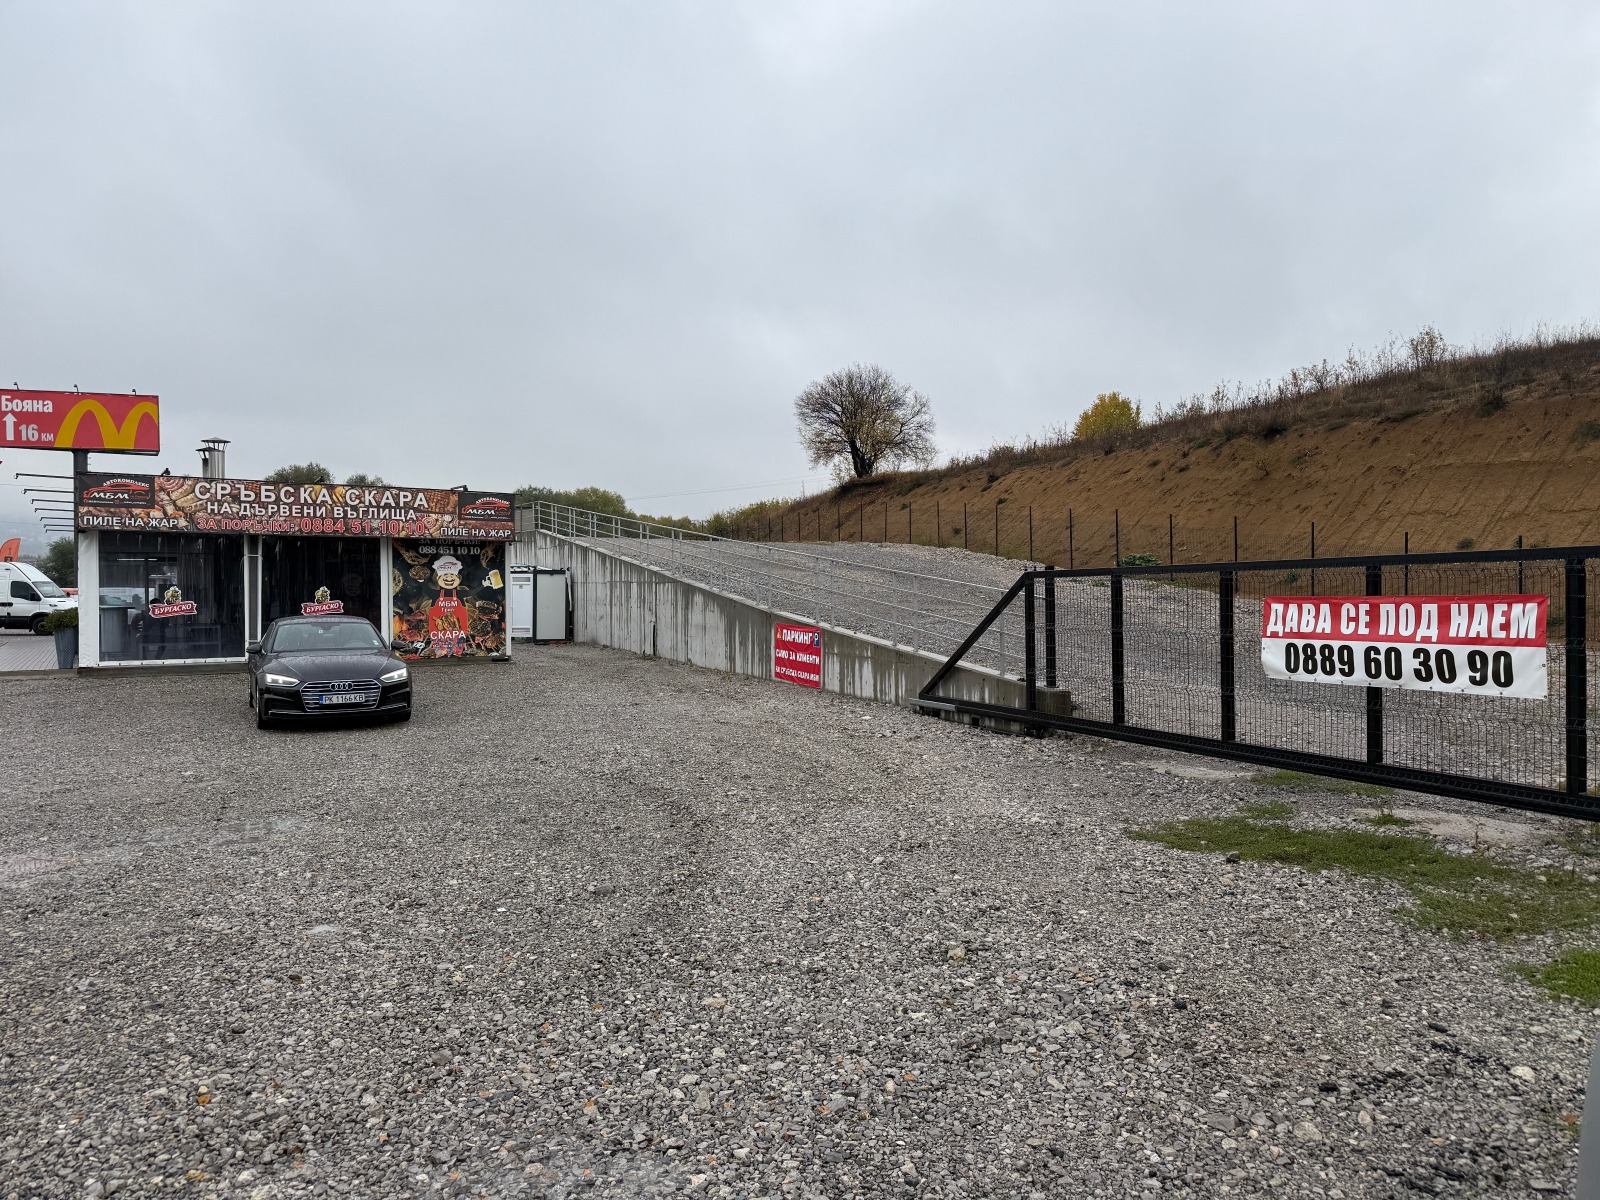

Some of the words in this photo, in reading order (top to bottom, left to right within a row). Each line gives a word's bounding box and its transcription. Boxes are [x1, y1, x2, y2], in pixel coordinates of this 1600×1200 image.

[1, 395, 53, 413] Бояна
[18, 424, 39, 442] 16
[90, 492, 130, 500] МБМ
[194, 482, 332, 504] СРЪБСКА
[345, 489, 429, 508] СКАРА
[207, 501, 232, 514] НА
[239, 504, 326, 518] ДЪРВЕНИ
[333, 506, 417, 522] ВЪГЛИЩА
[83, 516, 122, 527] ПИЛЕ
[125, 516, 145, 527] НА
[148, 518, 179, 529] ЖАР
[197, 518, 217, 530] ЗА
[221, 519, 295, 531] ПОРЪЧКИ:
[300, 517, 345, 534] 0884
[351, 519, 371, 534] 51
[378, 520, 399, 535] 10
[405, 521, 426, 536] 10
[439, 526, 469, 537] ПИЛЕ
[471, 527, 486, 538] НА
[487, 528, 512, 539] ЖАР
[418, 546, 436, 554] 088
[438, 546, 454, 554] 451
[470, 546, 480, 554] 10
[154, 604, 192, 614] БУРГАСКО
[306, 602, 339, 613] БУРГАСКО
[1266, 603, 1332, 637] ДАВА
[1340, 603, 1370, 635] СЕ
[1378, 603, 1439, 642] ПОД
[1448, 603, 1539, 640] НАЕМ
[430, 630, 467, 640] СКАРА
[782, 629, 813, 645] ПАРКИНГ
[1284, 642, 1356, 678] 0889
[1363, 645, 1403, 681] 60
[1412, 647, 1457, 684] 30
[1466, 649, 1514, 688] 90
[335, 695, 353, 704] 1166
